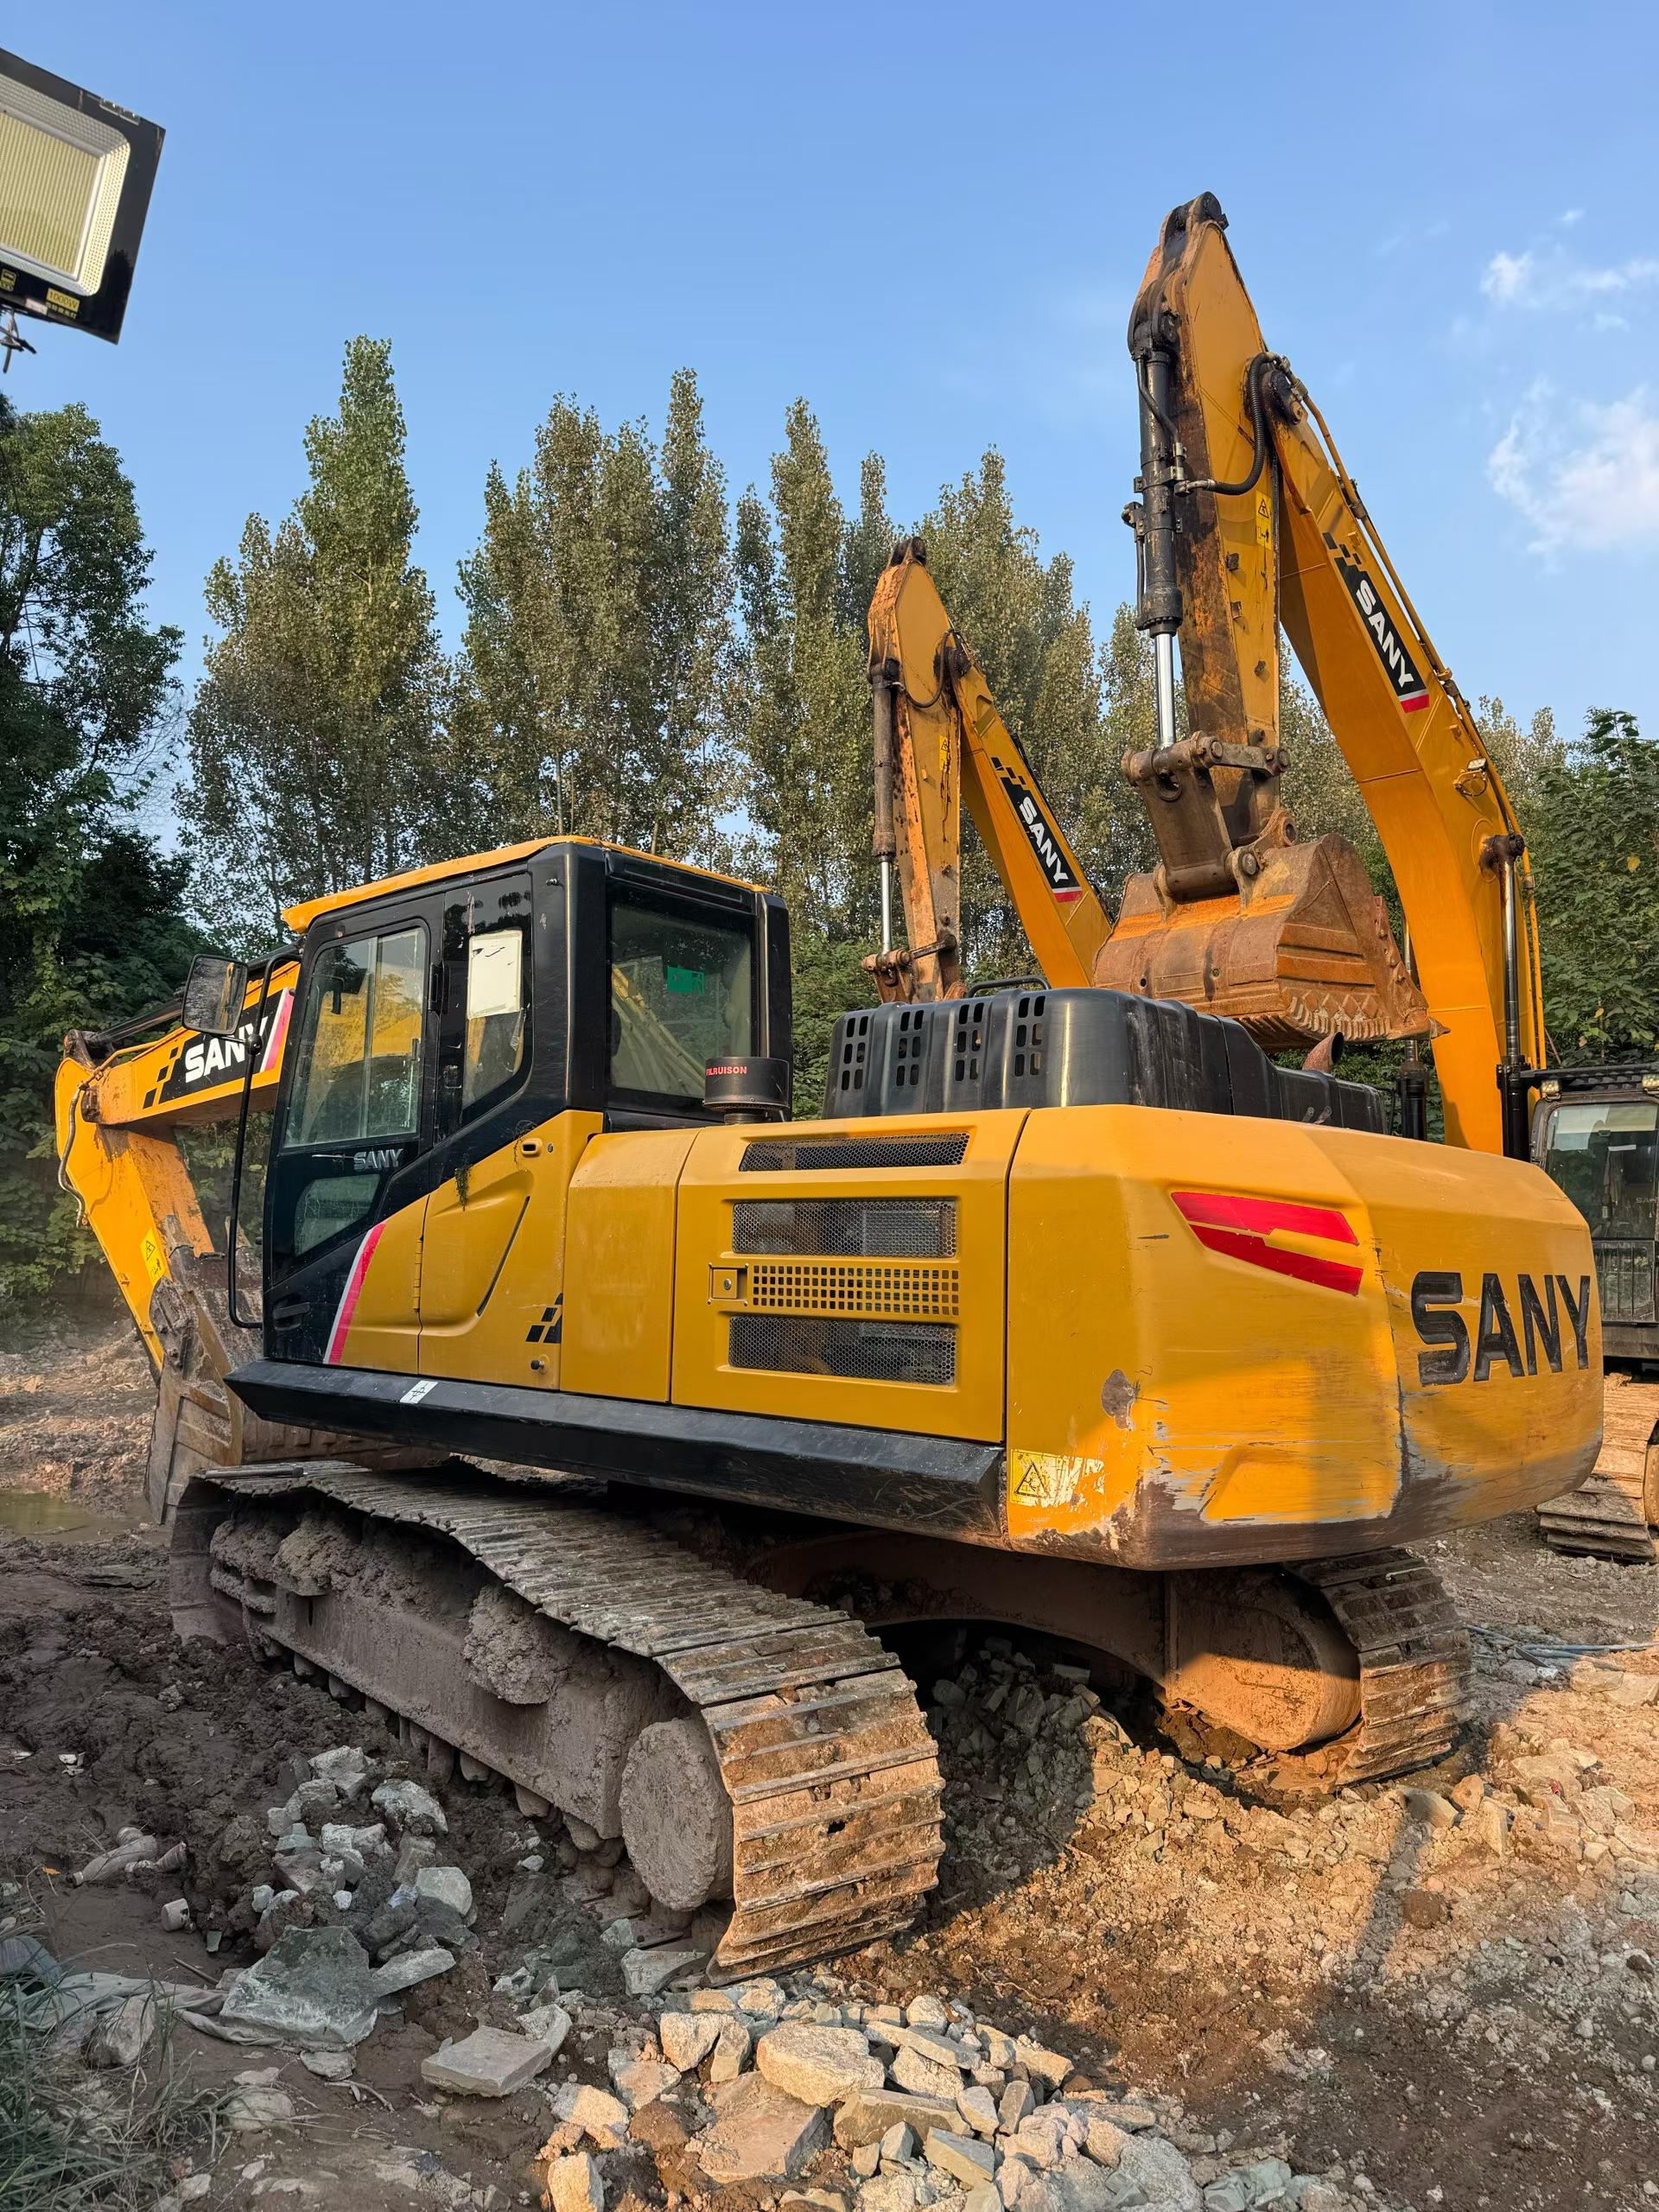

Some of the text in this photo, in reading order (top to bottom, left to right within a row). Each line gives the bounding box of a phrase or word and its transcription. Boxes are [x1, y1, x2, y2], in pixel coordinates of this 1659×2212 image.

[1356, 580, 1414, 688] SANY
[1020, 797, 1069, 883] SANY
[353, 1148, 404, 1170] SANY
[1411, 1271, 1591, 1387] SANY
